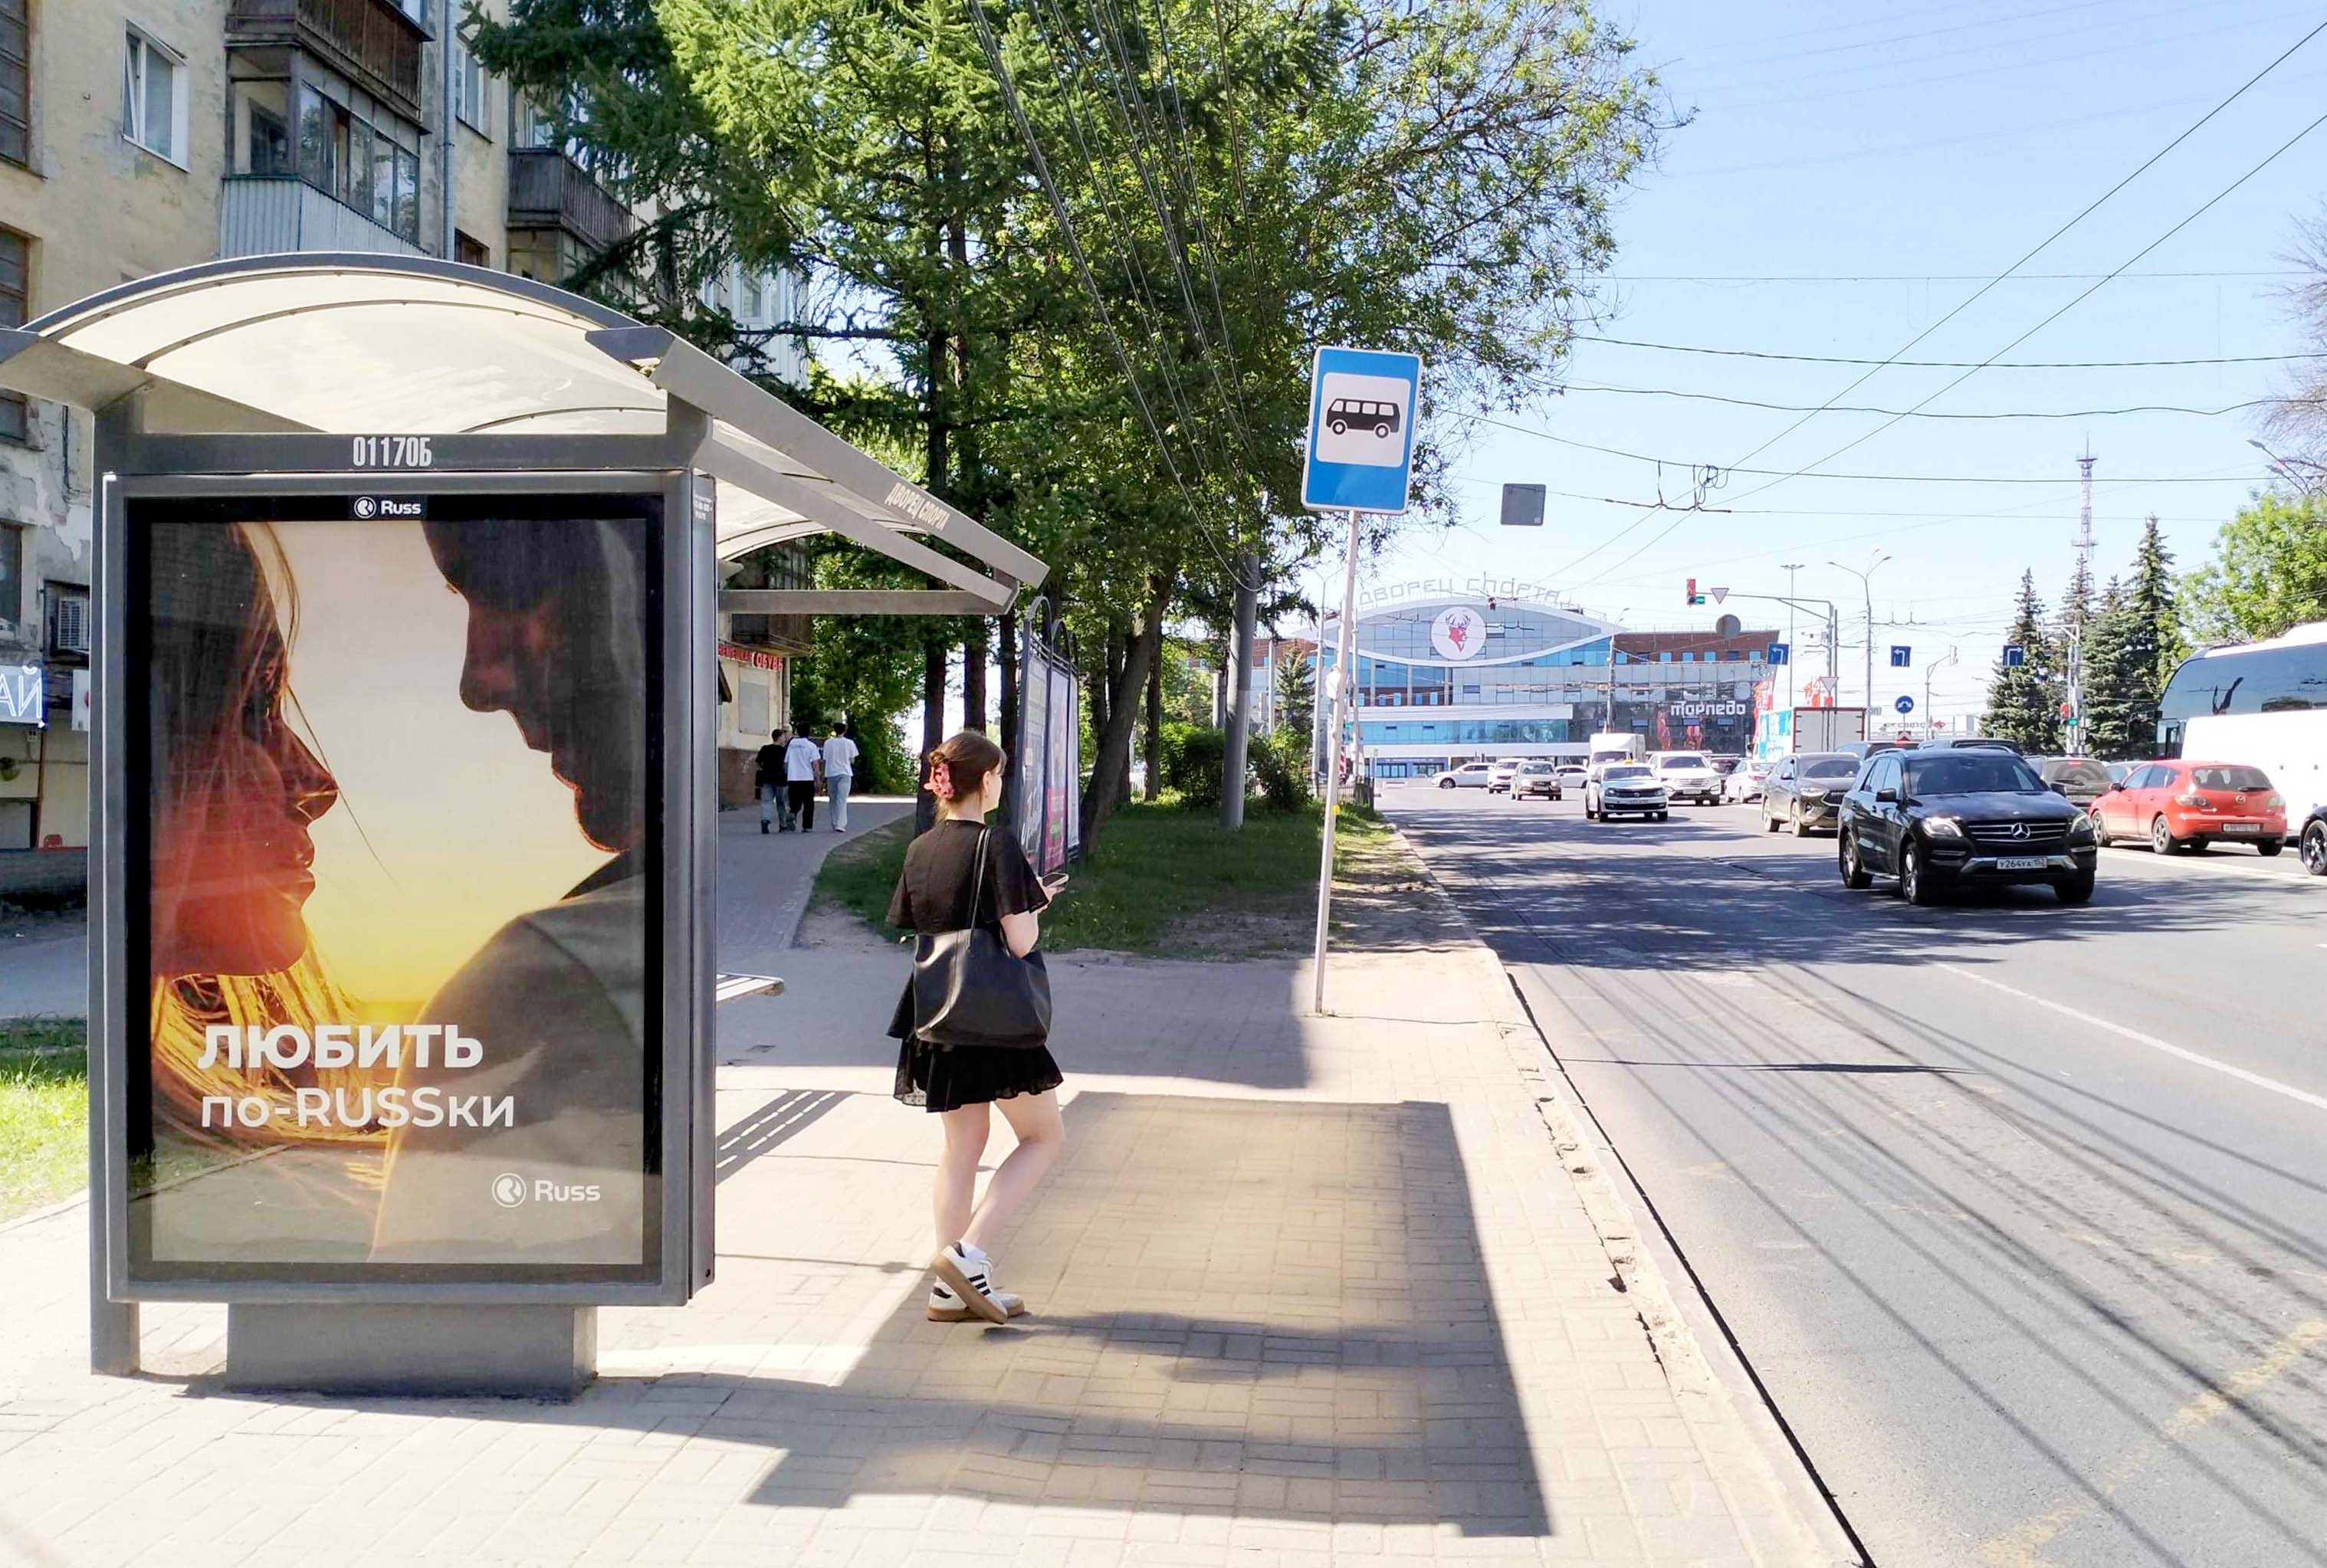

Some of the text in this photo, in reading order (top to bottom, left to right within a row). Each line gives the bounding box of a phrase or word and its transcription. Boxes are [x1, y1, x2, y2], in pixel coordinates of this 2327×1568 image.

[380, 500, 422, 515] Russ
[884, 482, 950, 532] ДВОРЕЦ СПОРТА
[197, 1024, 484, 1069] ЛЮБИТЬ
[201, 1086, 515, 1128] по-RUSSки
[534, 1179, 601, 1202] Russ
